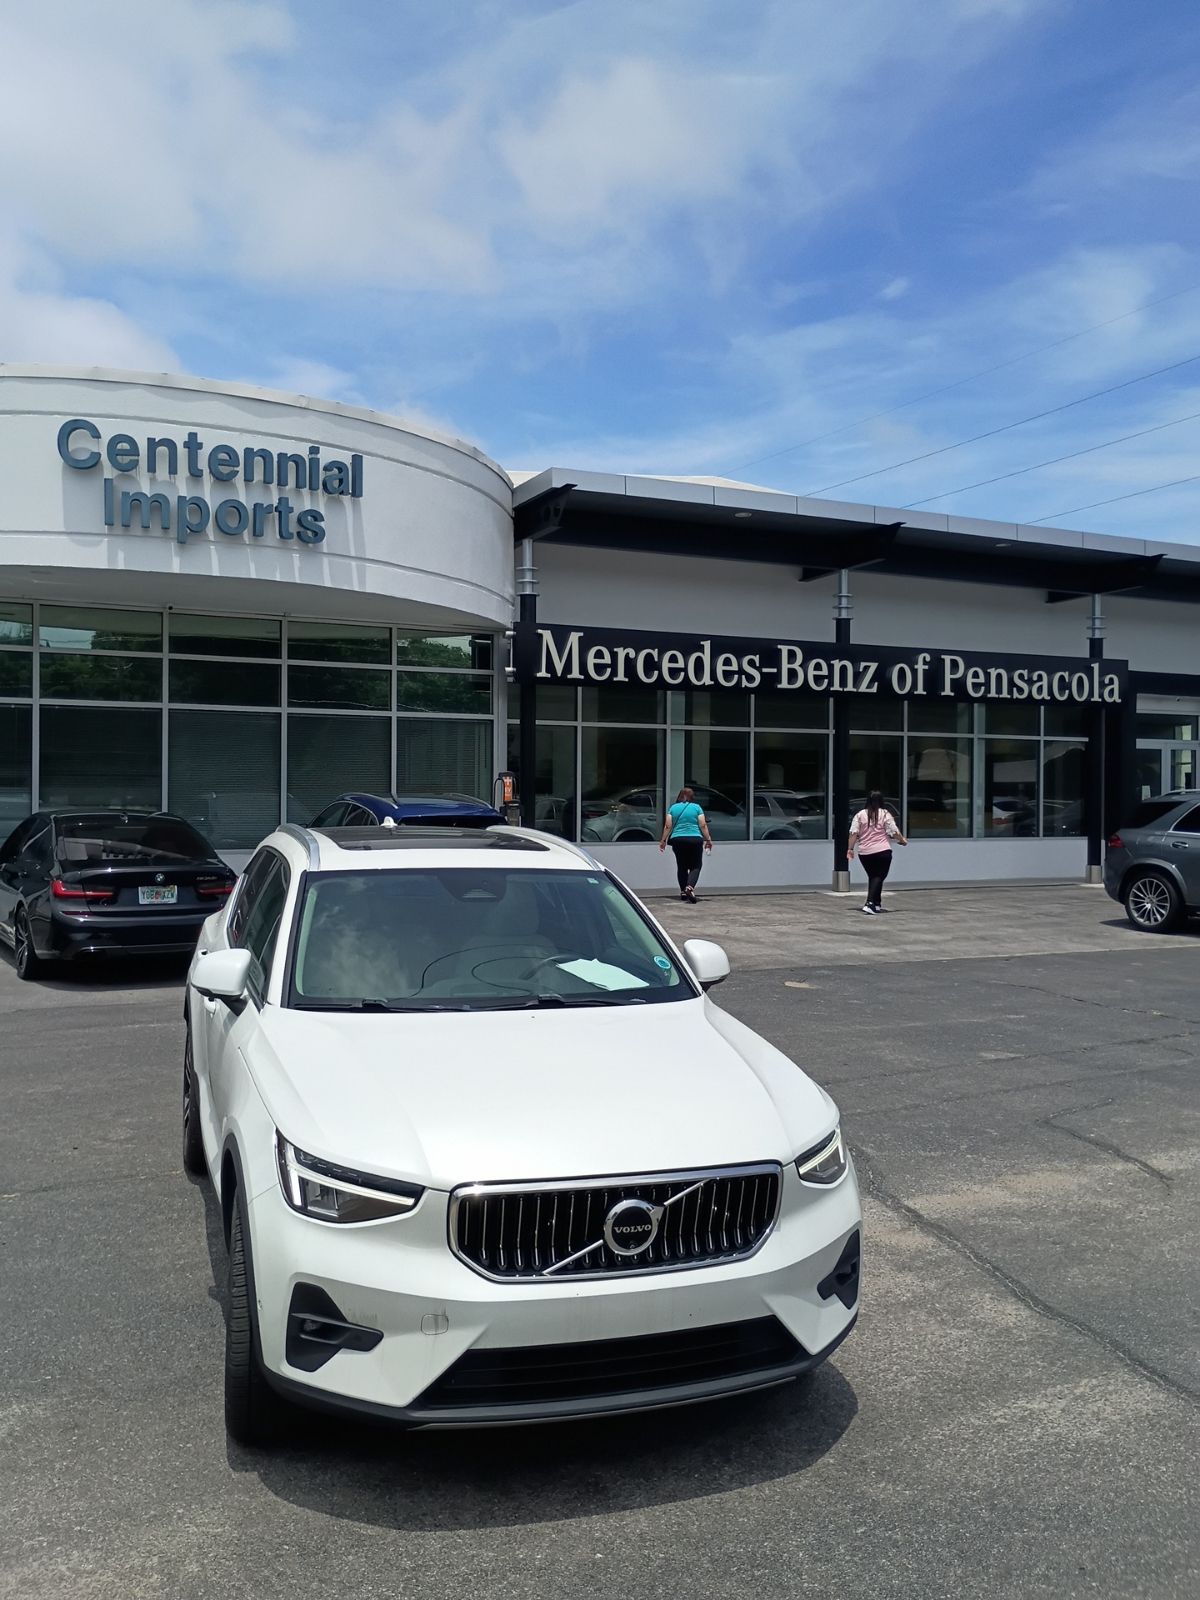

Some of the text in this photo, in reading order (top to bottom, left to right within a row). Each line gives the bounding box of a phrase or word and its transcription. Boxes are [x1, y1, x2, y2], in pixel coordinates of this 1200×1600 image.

[57, 418, 363, 498] Centennial
[104, 477, 326, 544] Imports
[536, 629, 1122, 703] Mercedes-Benz of Pensacola
[613, 1224, 652, 1234] VOLVO
